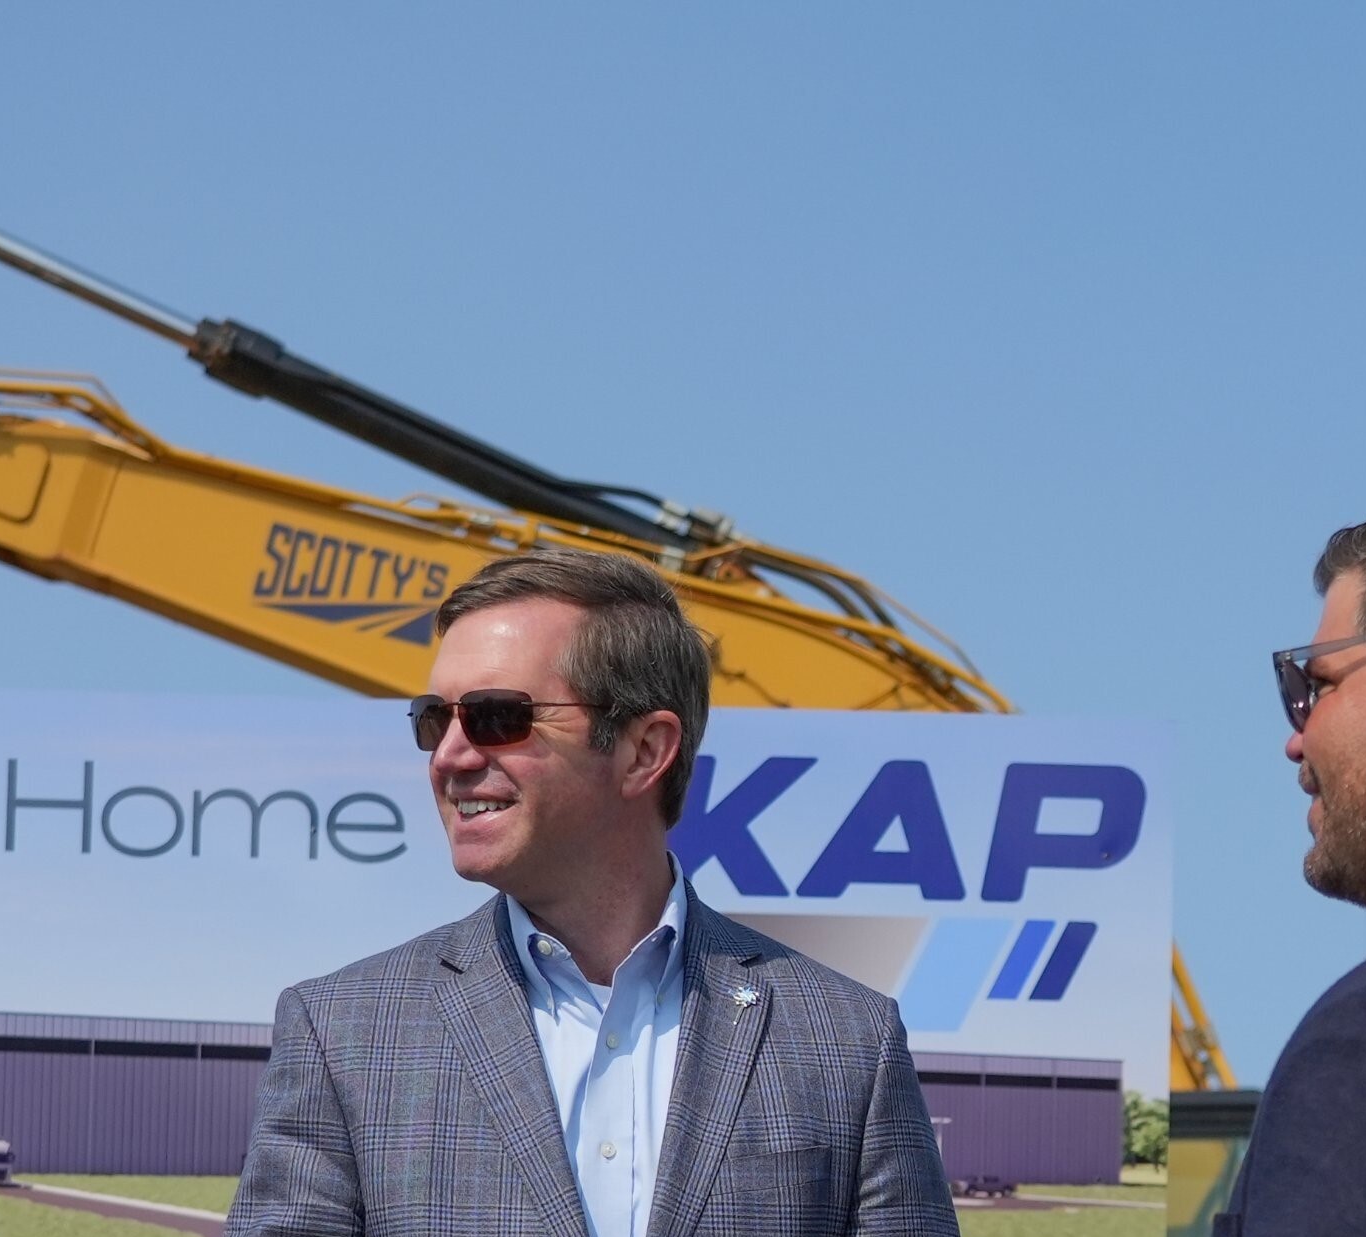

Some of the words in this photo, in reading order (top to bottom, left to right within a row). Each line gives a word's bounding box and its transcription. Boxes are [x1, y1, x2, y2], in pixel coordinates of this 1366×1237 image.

[253, 523, 450, 598] SCOTTY'S
[4, 758, 410, 863] Home
[666, 755, 1148, 902] KAP
